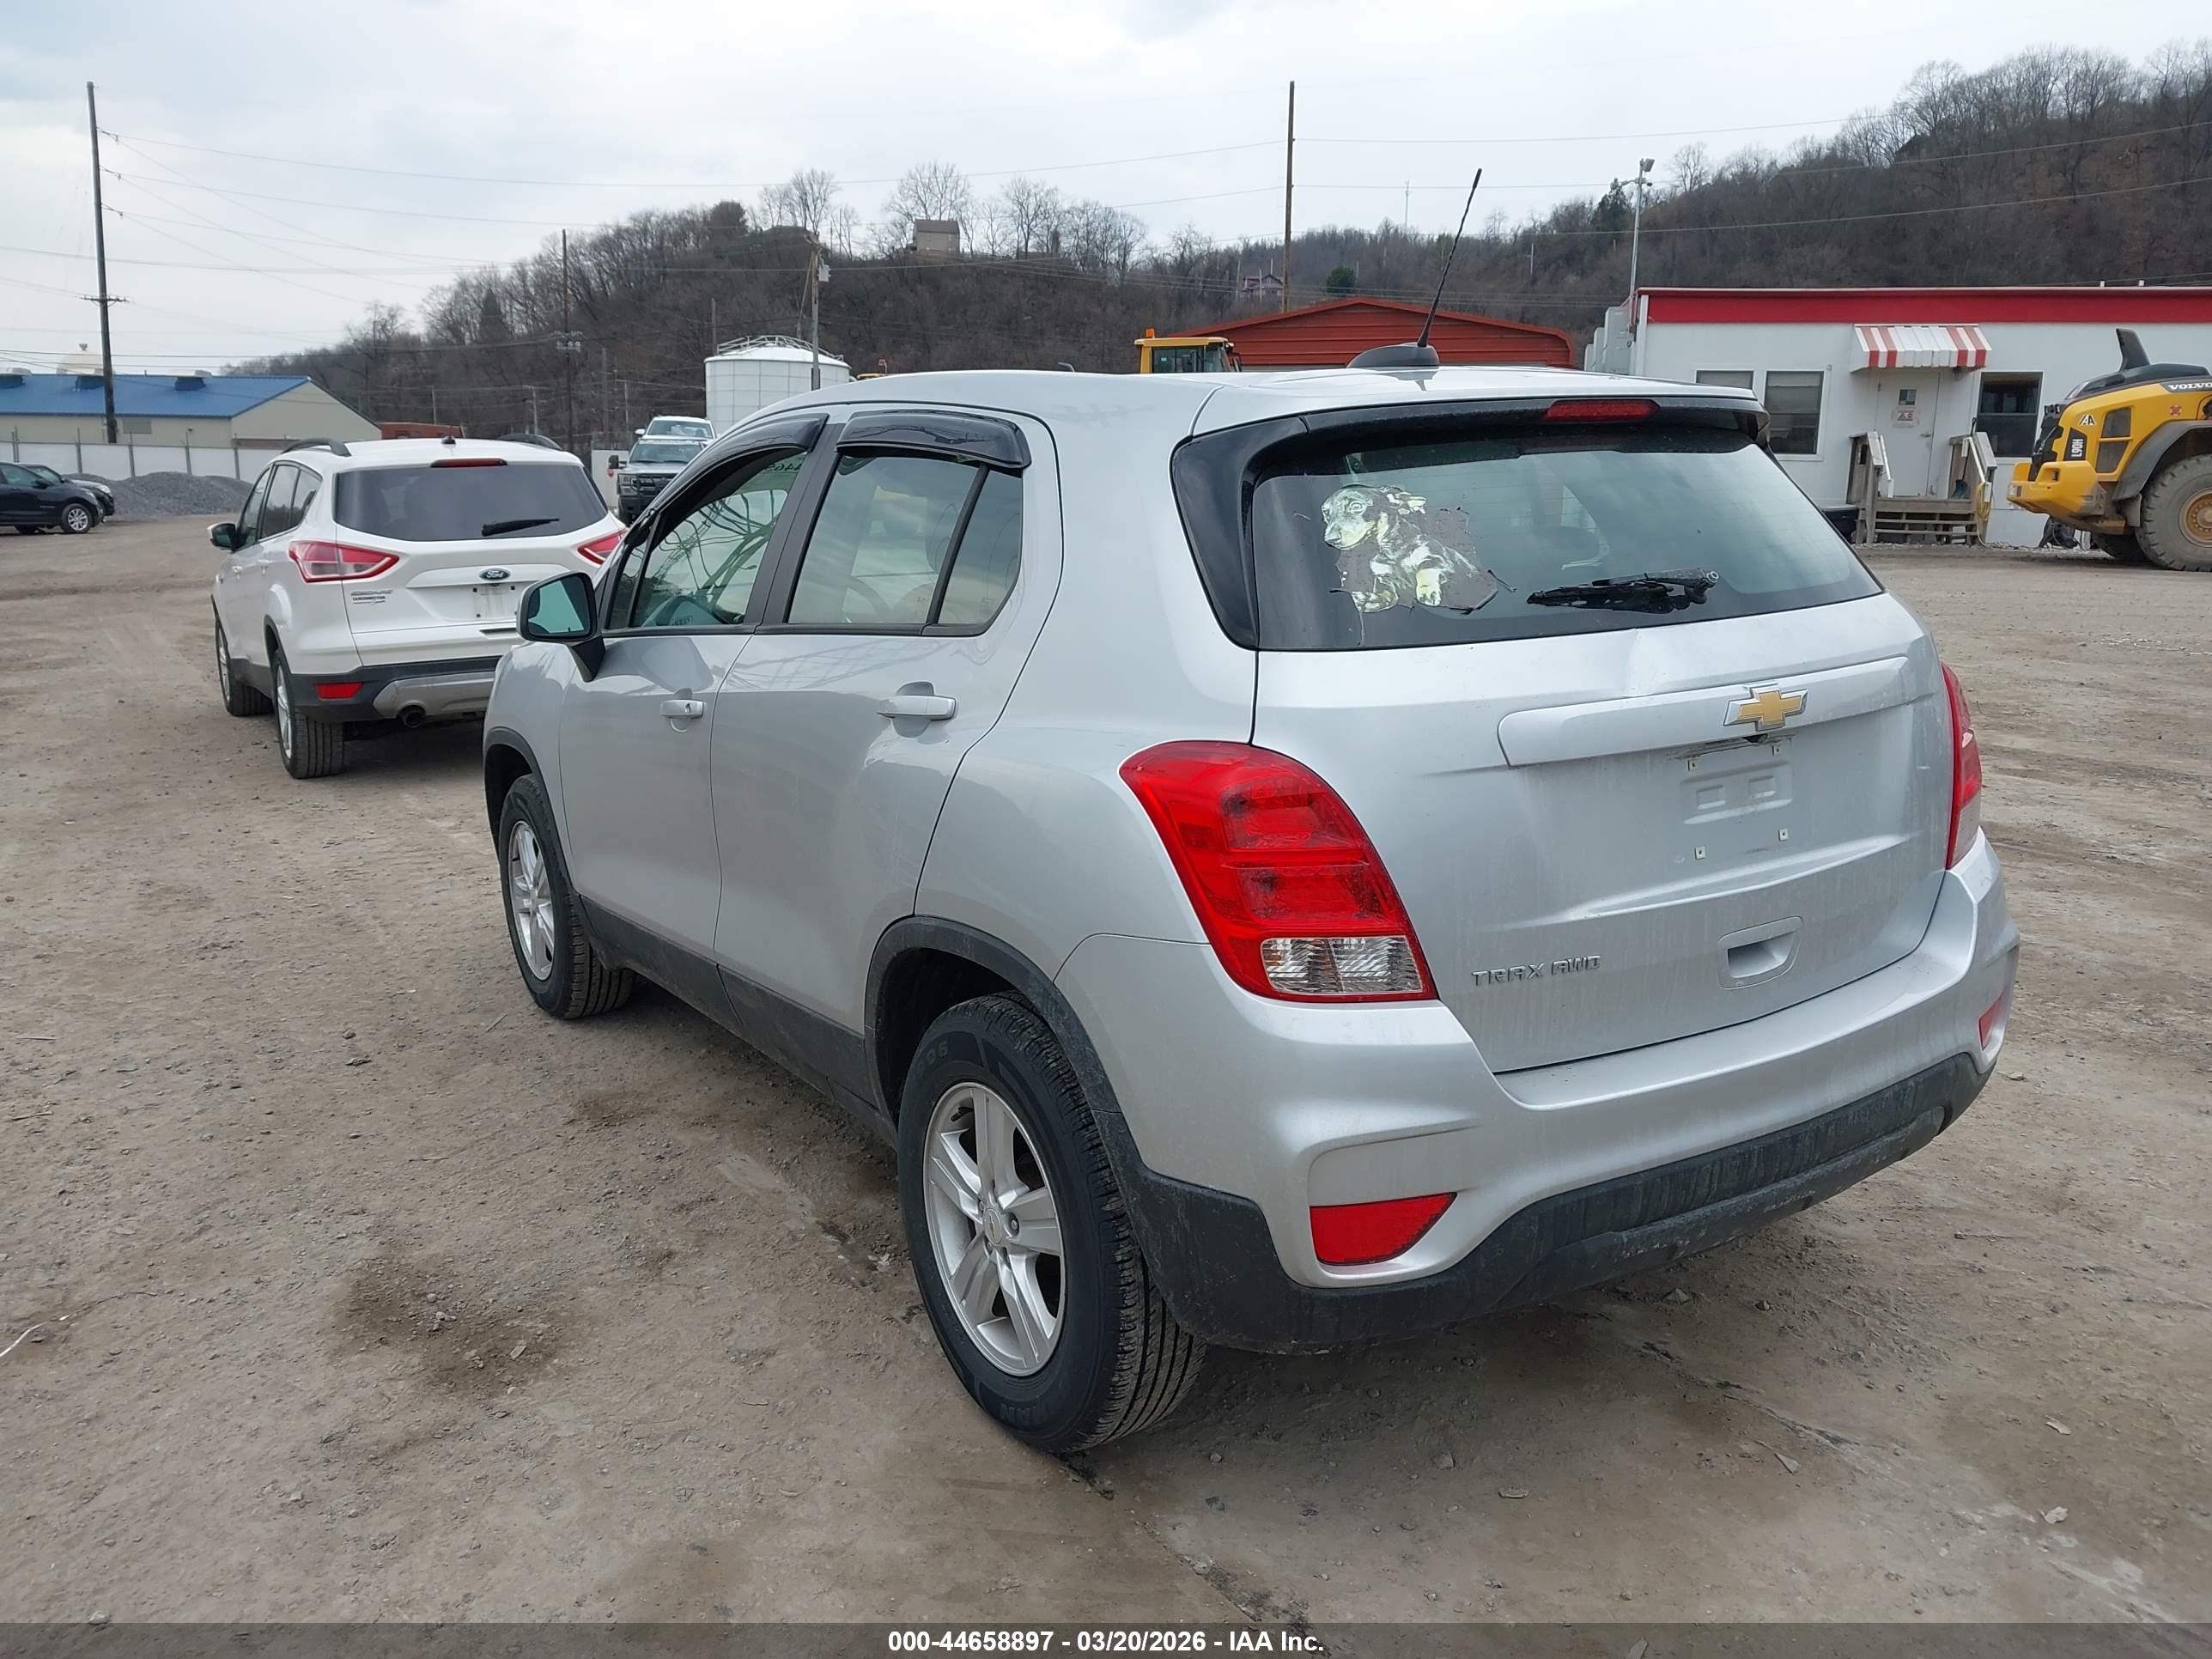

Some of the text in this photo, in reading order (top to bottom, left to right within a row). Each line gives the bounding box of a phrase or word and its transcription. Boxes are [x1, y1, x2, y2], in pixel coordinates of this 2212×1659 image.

[2071, 439, 2084, 458] L90H
[1471, 954, 1601, 987] TRAX AWD
